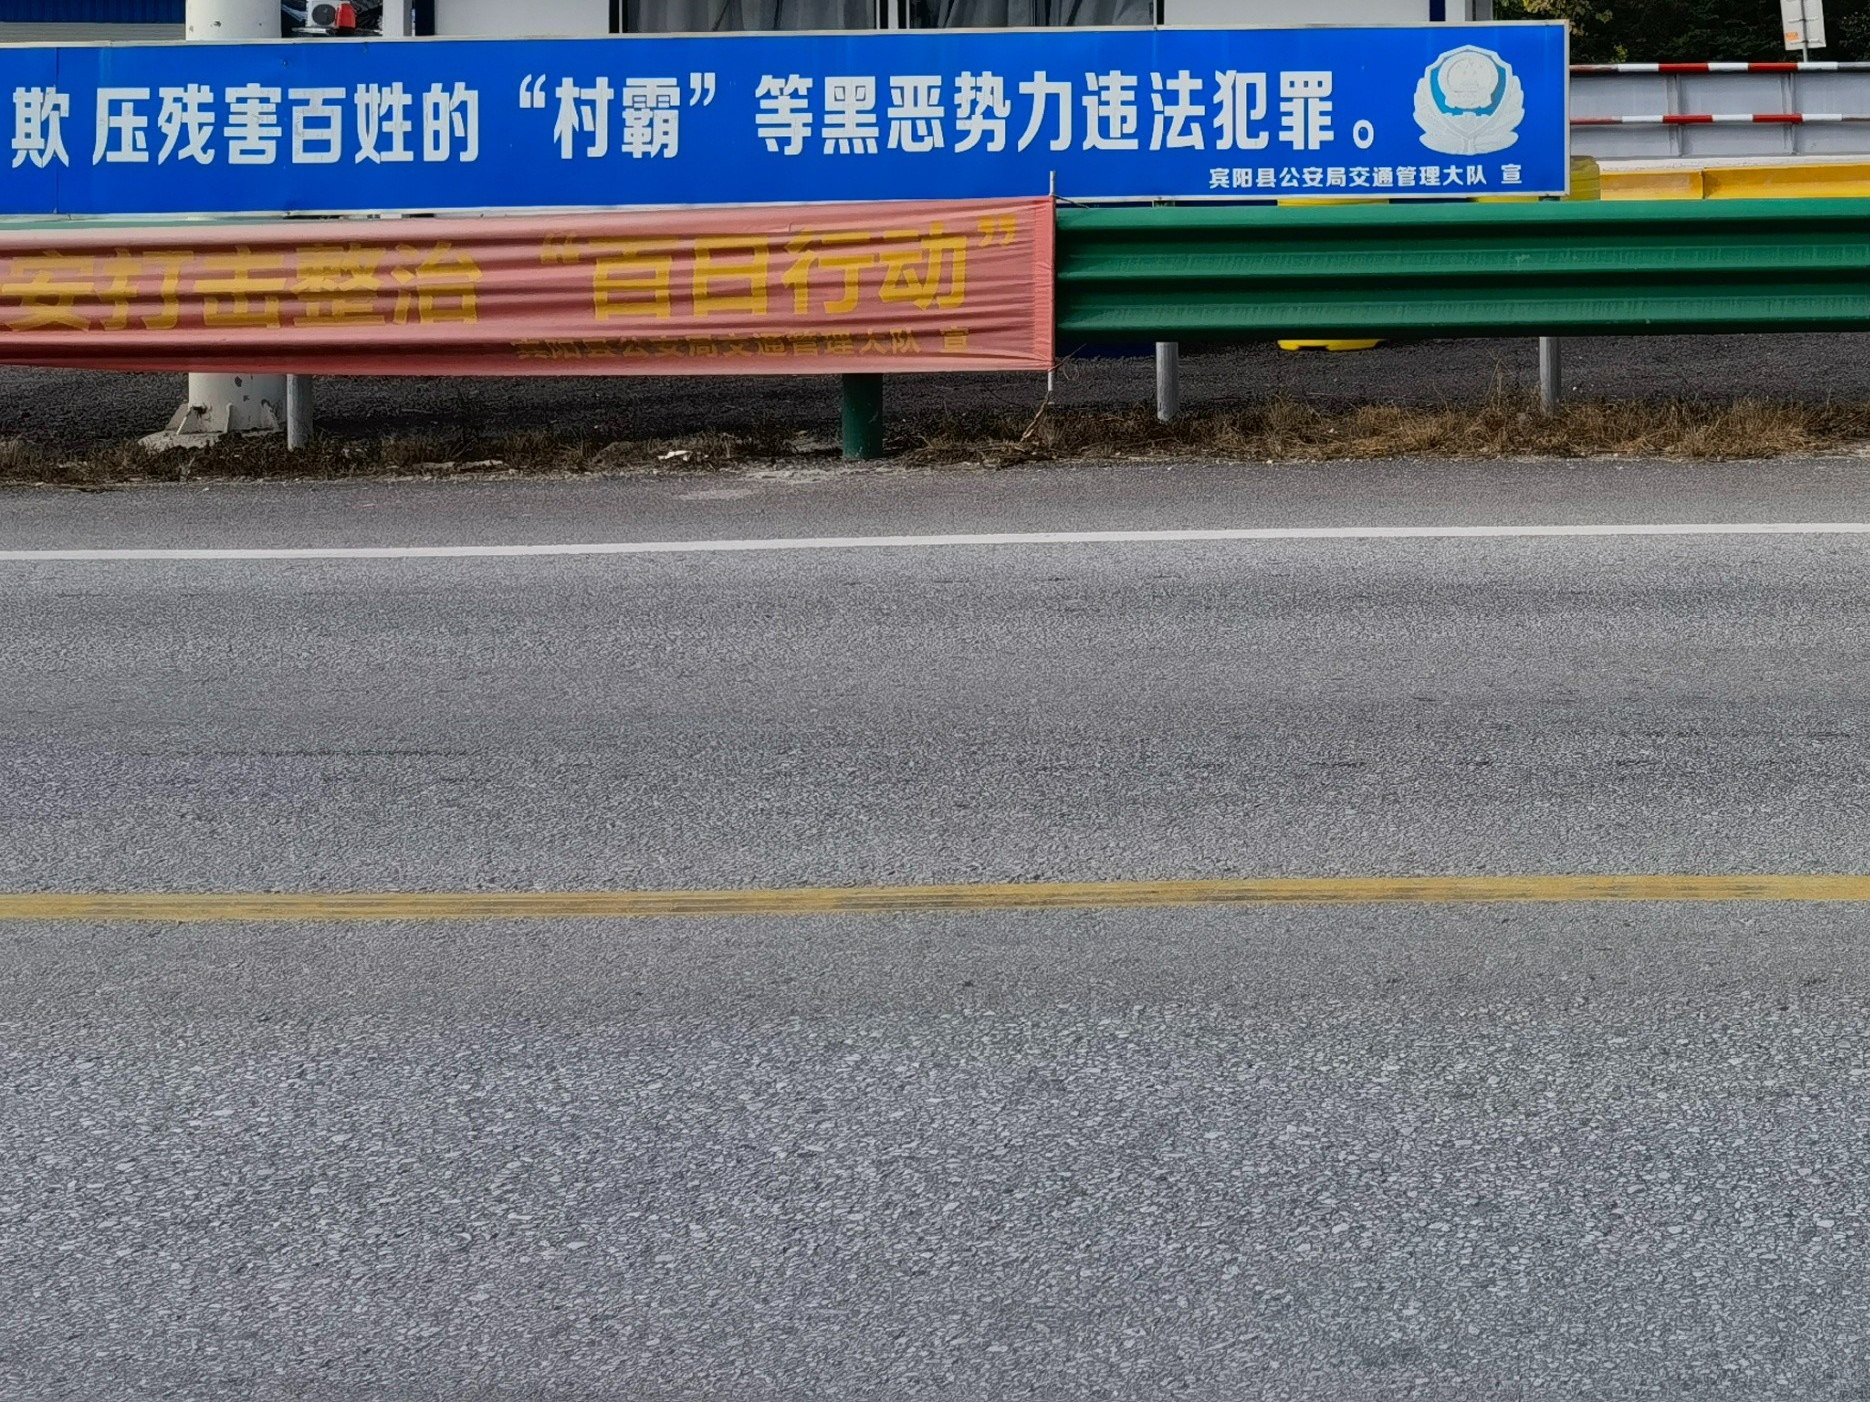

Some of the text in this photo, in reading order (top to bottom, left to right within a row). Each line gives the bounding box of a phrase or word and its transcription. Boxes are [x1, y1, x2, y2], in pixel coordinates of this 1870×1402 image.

[1208, 163, 1522, 190] 宾阳县公安局交通管理大队 宣
[939, 325, 968, 354] 宣
